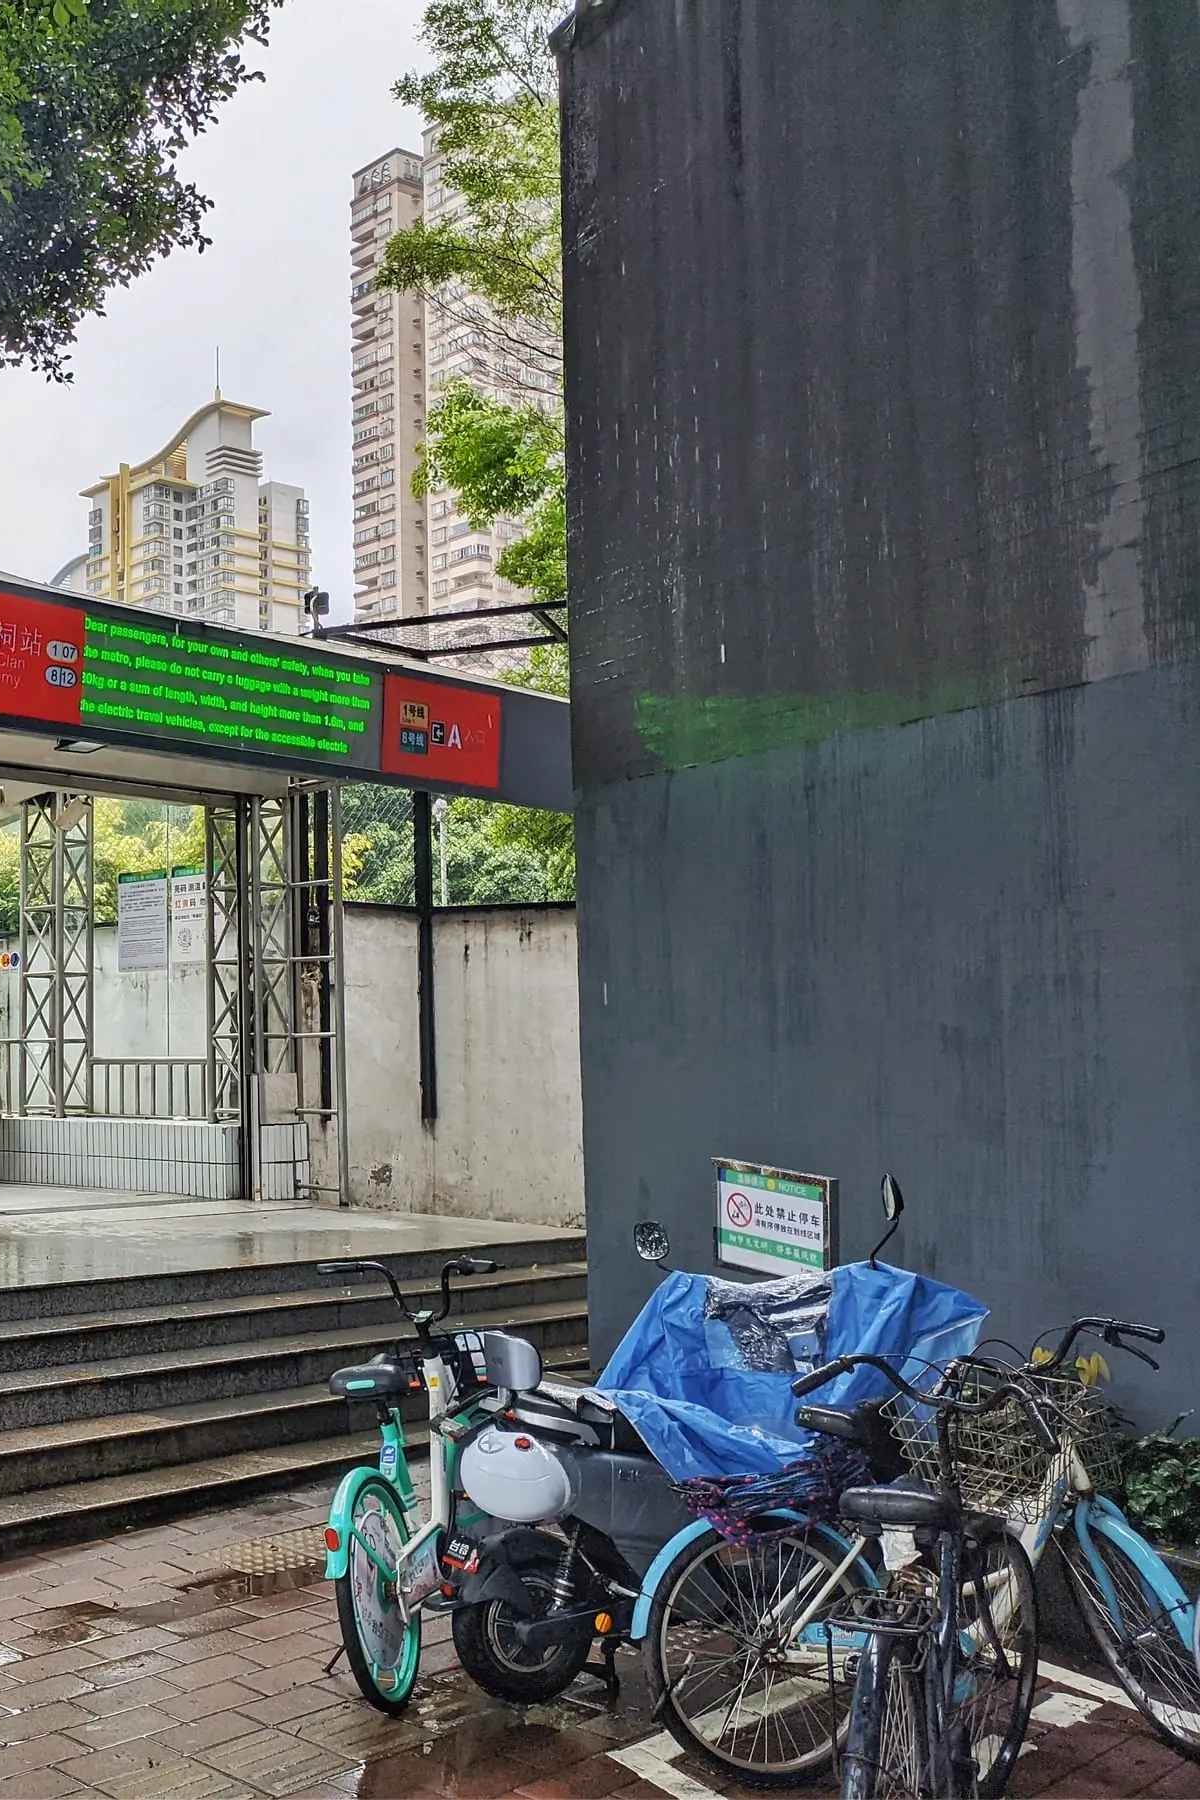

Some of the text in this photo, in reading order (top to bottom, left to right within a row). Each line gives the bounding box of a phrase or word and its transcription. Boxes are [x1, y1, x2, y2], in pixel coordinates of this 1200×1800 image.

[62, 646, 76, 660] 07
[84, 617, 108, 633] Dear
[110, 624, 169, 648] passengers,
[171, 636, 186, 649] for
[187, 641, 208, 653] your
[210, 646, 229, 658] own
[231, 650, 248, 661] and
[281, 660, 310, 676] safety,
[312, 664, 334, 679] when
[336, 670, 351, 682] you
[353, 672, 370, 686] take
[61, 672, 74, 685] 12
[101, 649, 132, 667] metro,
[135, 656, 167, 671] please
[170, 662, 182, 674] do
[185, 666, 200, 678] not
[202, 670, 225, 685] carry
[227, 675, 233, 684] a
[235, 674, 271, 692] luggage
[273, 682, 291, 695] with
[292, 686, 299, 696] a
[300, 688, 329, 703] weight
[330, 692, 350, 705] more
[352, 695, 370, 710] than
[107, 678, 119, 689] or
[120, 681, 127, 691] a
[129, 683, 150, 695] sum
[153, 685, 164, 697] of
[165, 687, 198, 705] length,
[200, 694, 227, 711] width,
[230, 700, 248, 712] and
[250, 702, 278, 718] height
[280, 708, 300, 720] more
[302, 711, 321, 724] than
[348, 720, 364, 732] and
[403, 703, 425, 719] 1号线
[98, 702, 134, 719] electric
[136, 708, 163, 723] travel
[165, 714, 206, 732] vehicles,
[208, 723, 239, 738] except
[241, 725, 254, 738] for
[255, 728, 270, 740] the
[271, 732, 316, 748] accessible
[317, 739, 348, 753] electric
[402, 731, 425, 747] 8号线
[447, 724, 462, 749] A
[778, 1182, 807, 1196] NOTICE
[754, 1201, 820, 1228] 此处禁止停车
